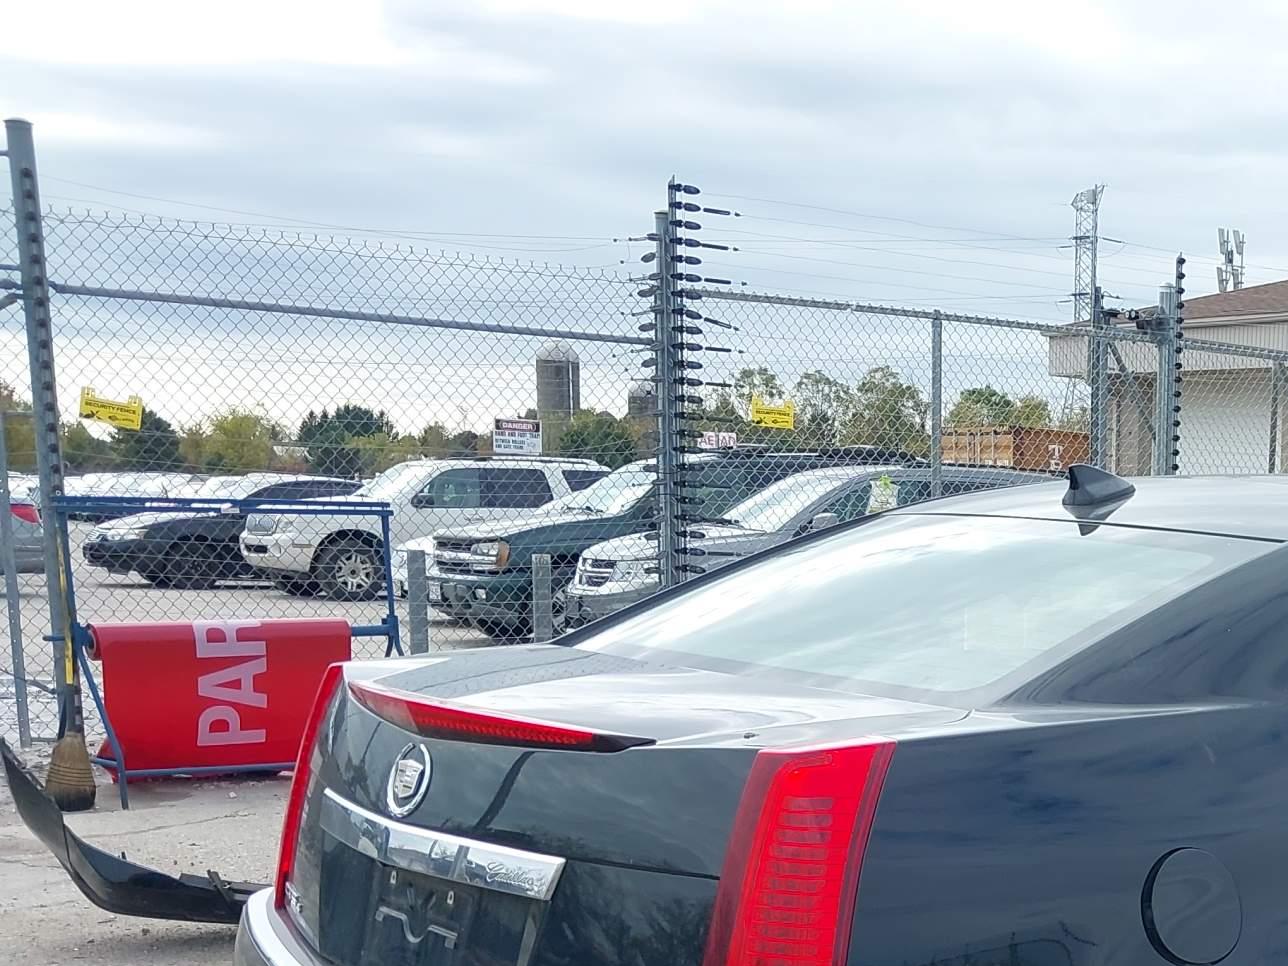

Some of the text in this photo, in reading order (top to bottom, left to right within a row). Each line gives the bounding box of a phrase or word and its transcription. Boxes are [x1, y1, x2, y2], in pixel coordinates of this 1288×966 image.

[84, 401, 136, 415] SECURITY FENCE
[502, 422, 533, 430] DANGER
[192, 619, 268, 747] PAR
